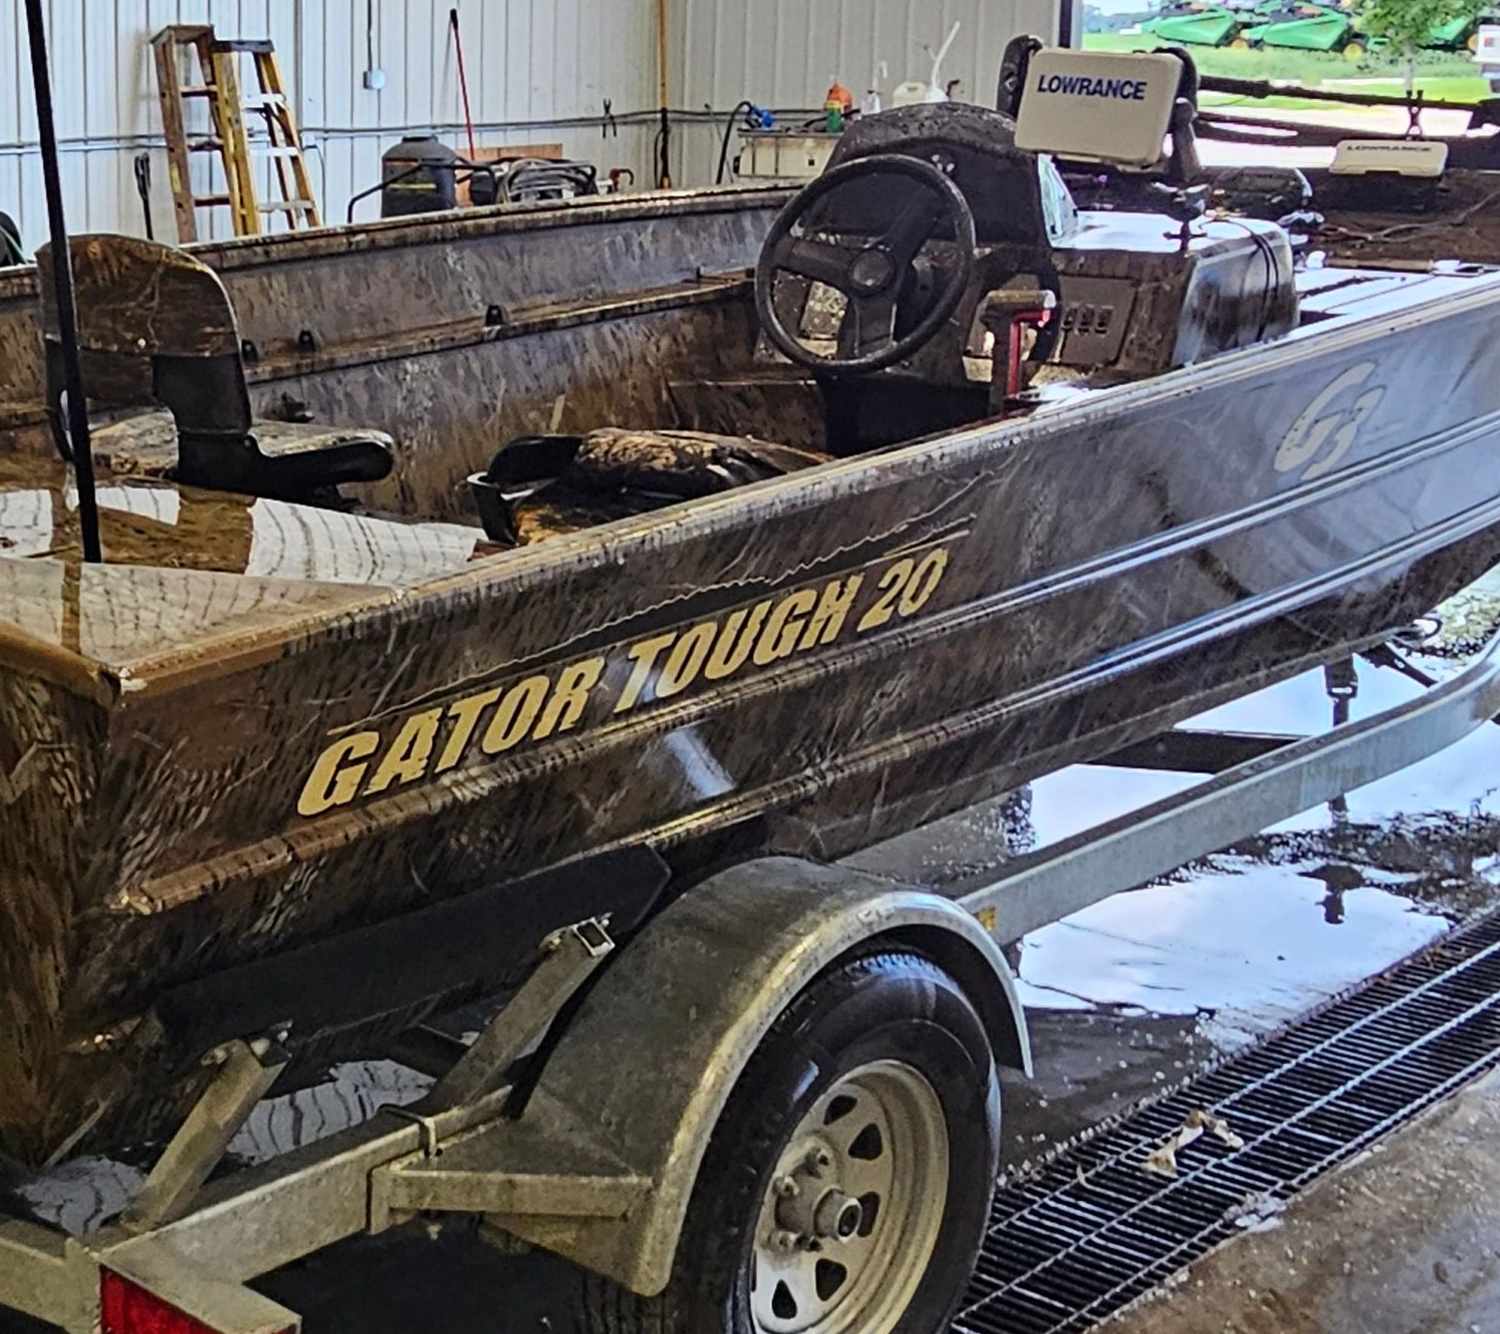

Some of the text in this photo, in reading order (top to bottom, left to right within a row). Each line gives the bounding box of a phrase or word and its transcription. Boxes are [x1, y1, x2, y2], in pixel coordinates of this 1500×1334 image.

[1037, 74, 1148, 100] LOWRANCE
[1273, 359, 1387, 482] G3
[297, 547, 948, 816] GATOR TOUGH 20
